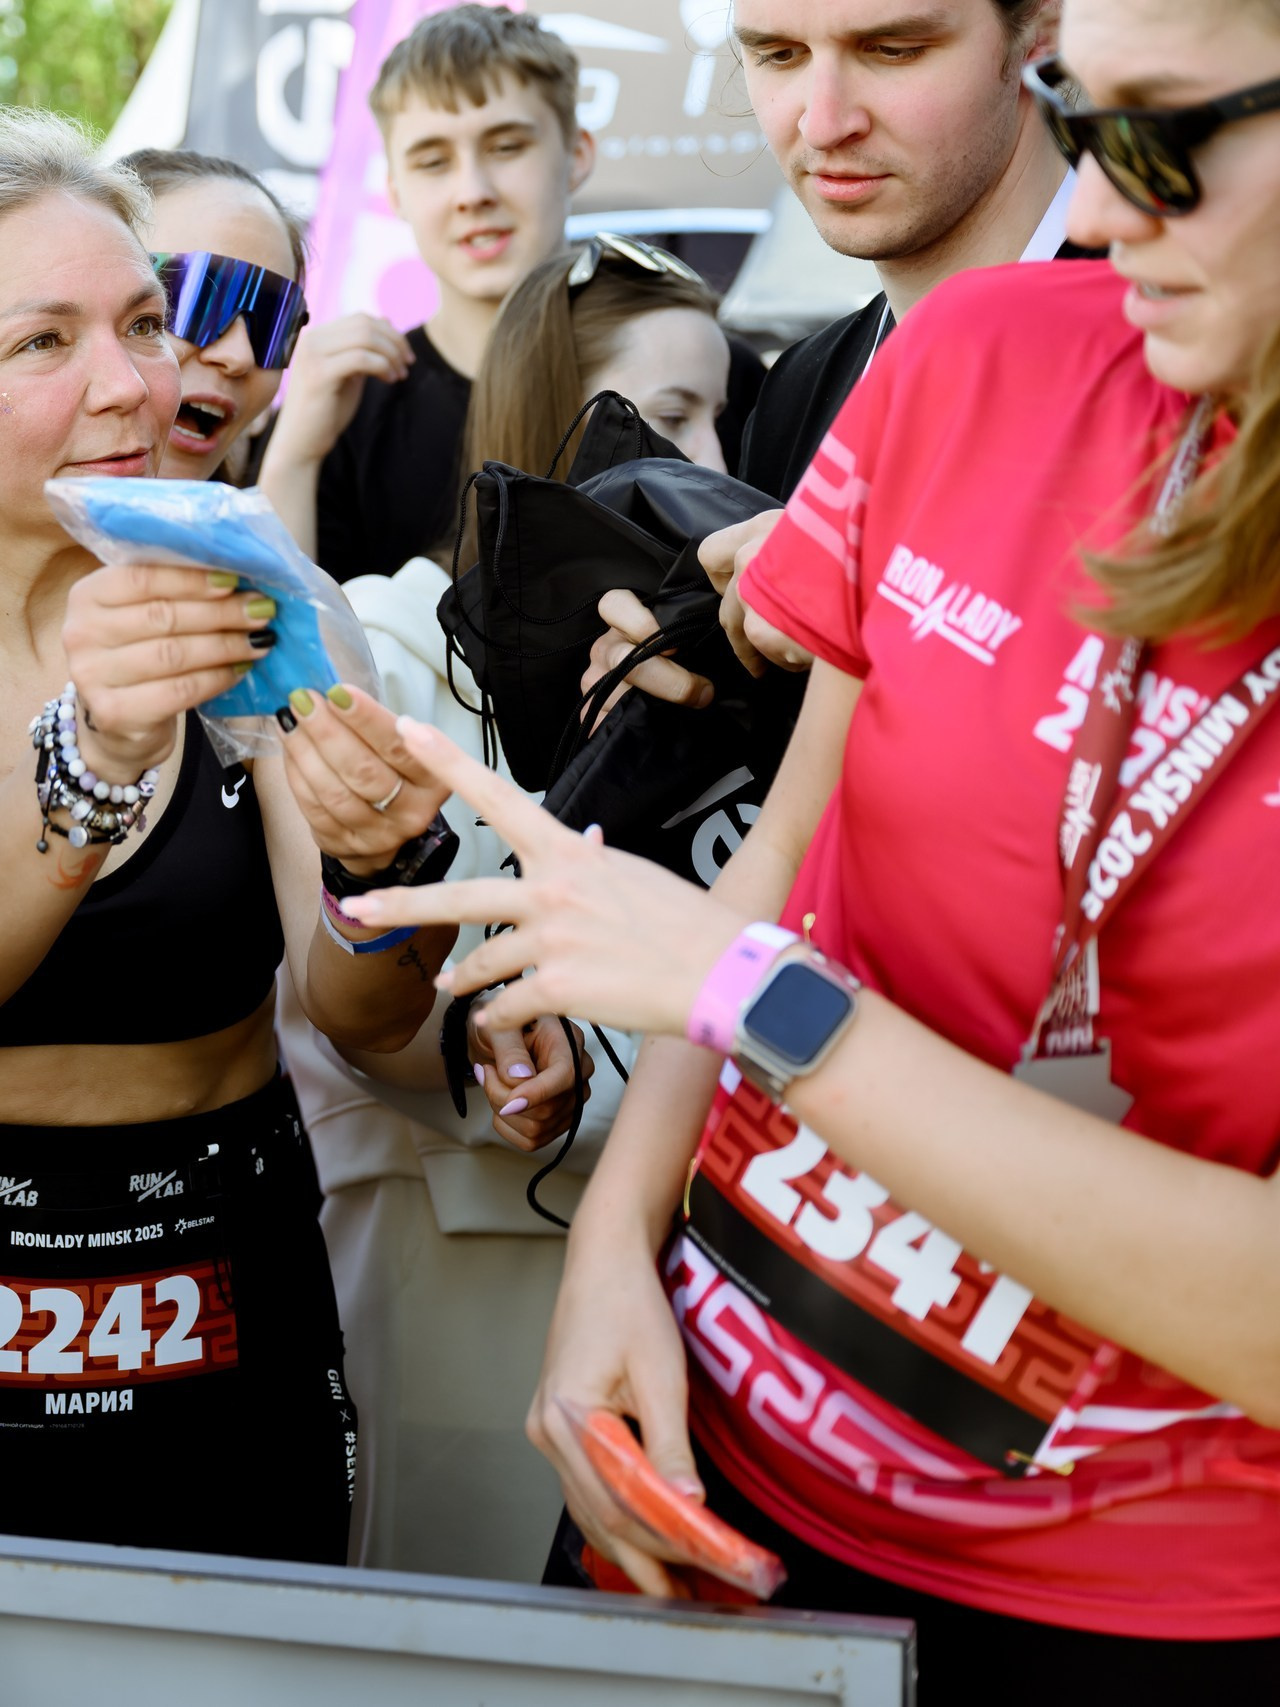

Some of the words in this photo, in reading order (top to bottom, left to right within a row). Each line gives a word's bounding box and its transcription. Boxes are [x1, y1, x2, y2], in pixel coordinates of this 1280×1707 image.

[883, 543, 945, 606] IRON
[946, 583, 1023, 652] LADY
[1128, 692, 1251, 830] MINSK
[129, 1171, 163, 1193] RUN
[154, 1180, 184, 1200] LAB
[3, 1190, 40, 1208] LAB
[186, 1215, 215, 1229] BELSTAR
[10, 1230, 85, 1249] IRONLADY
[87, 1228, 133, 1248] MINSK
[134, 1223, 164, 1242] 2025
[45, 1389, 134, 1415] МАРИЯ
